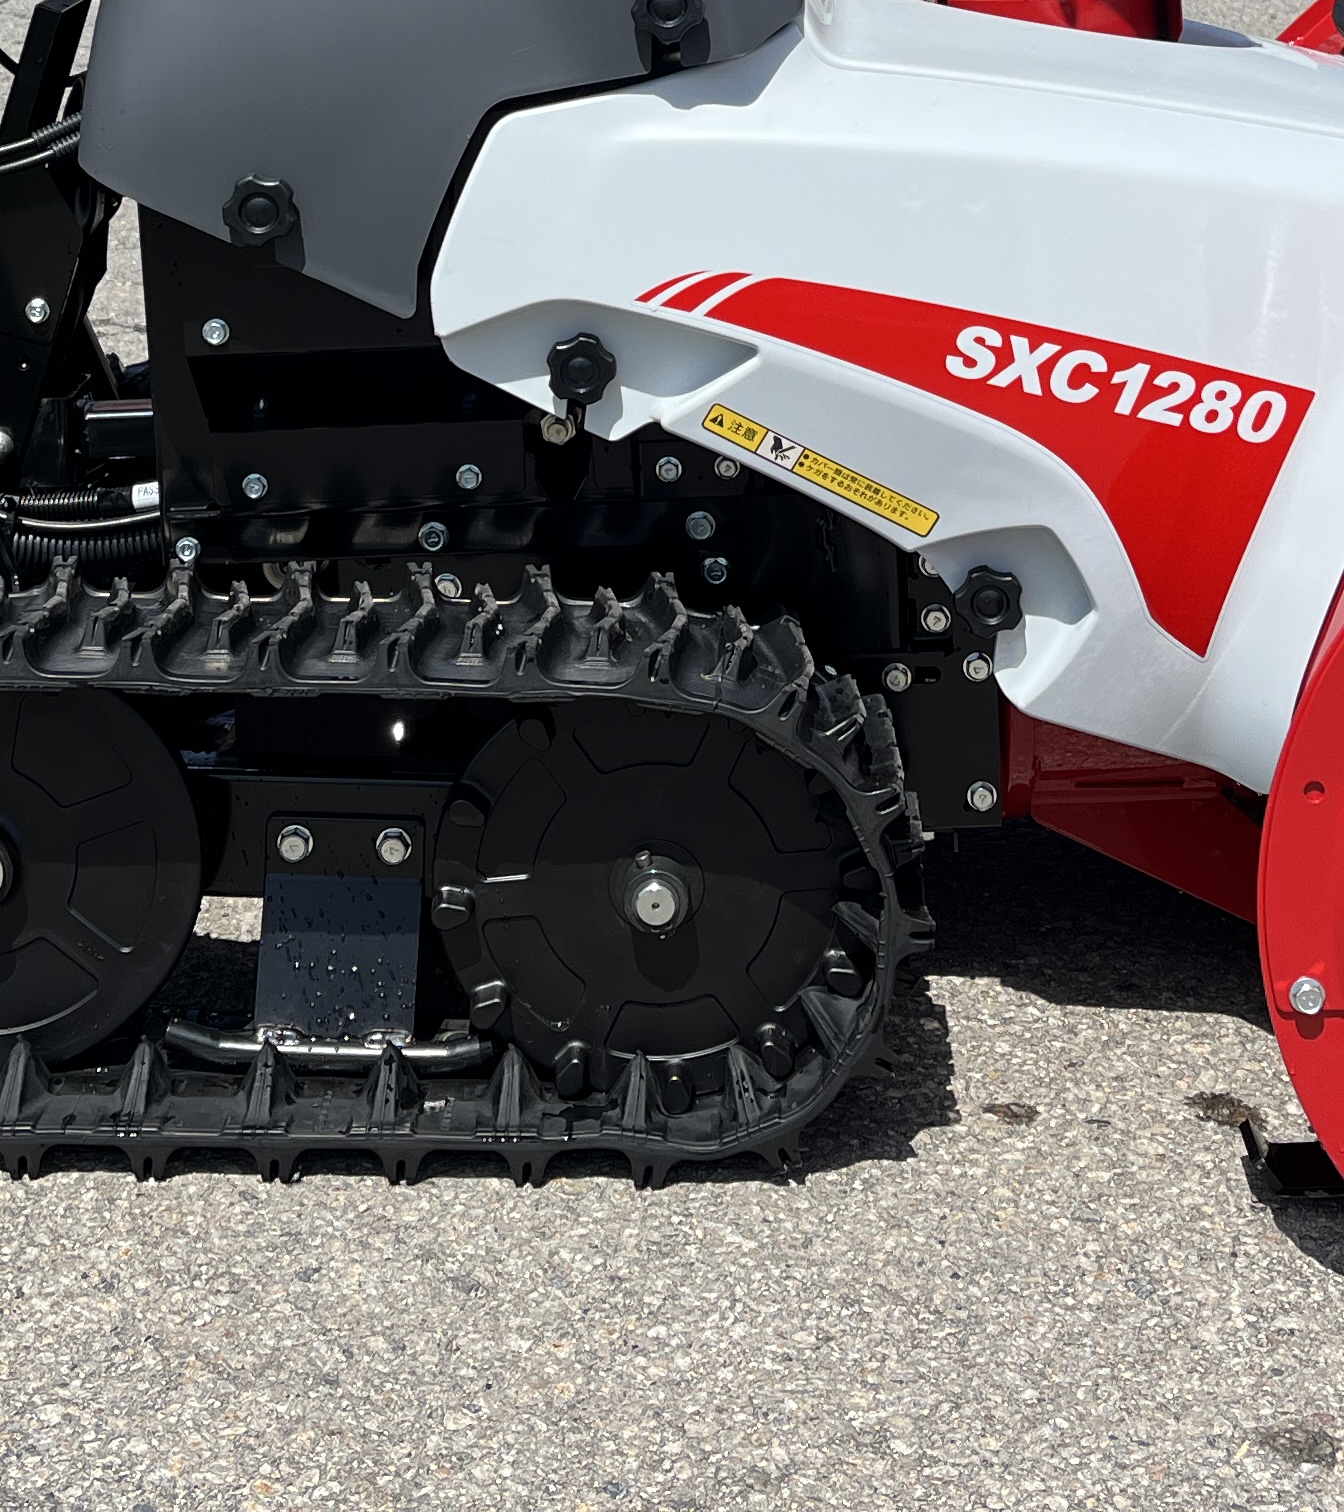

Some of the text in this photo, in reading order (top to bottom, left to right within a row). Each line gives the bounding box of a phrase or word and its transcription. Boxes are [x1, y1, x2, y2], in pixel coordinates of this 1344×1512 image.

[945, 325, 1289, 445] SXC1280
[727, 418, 760, 443] 注意
[805, 464, 910, 521] ケガをするおそれがあります。
